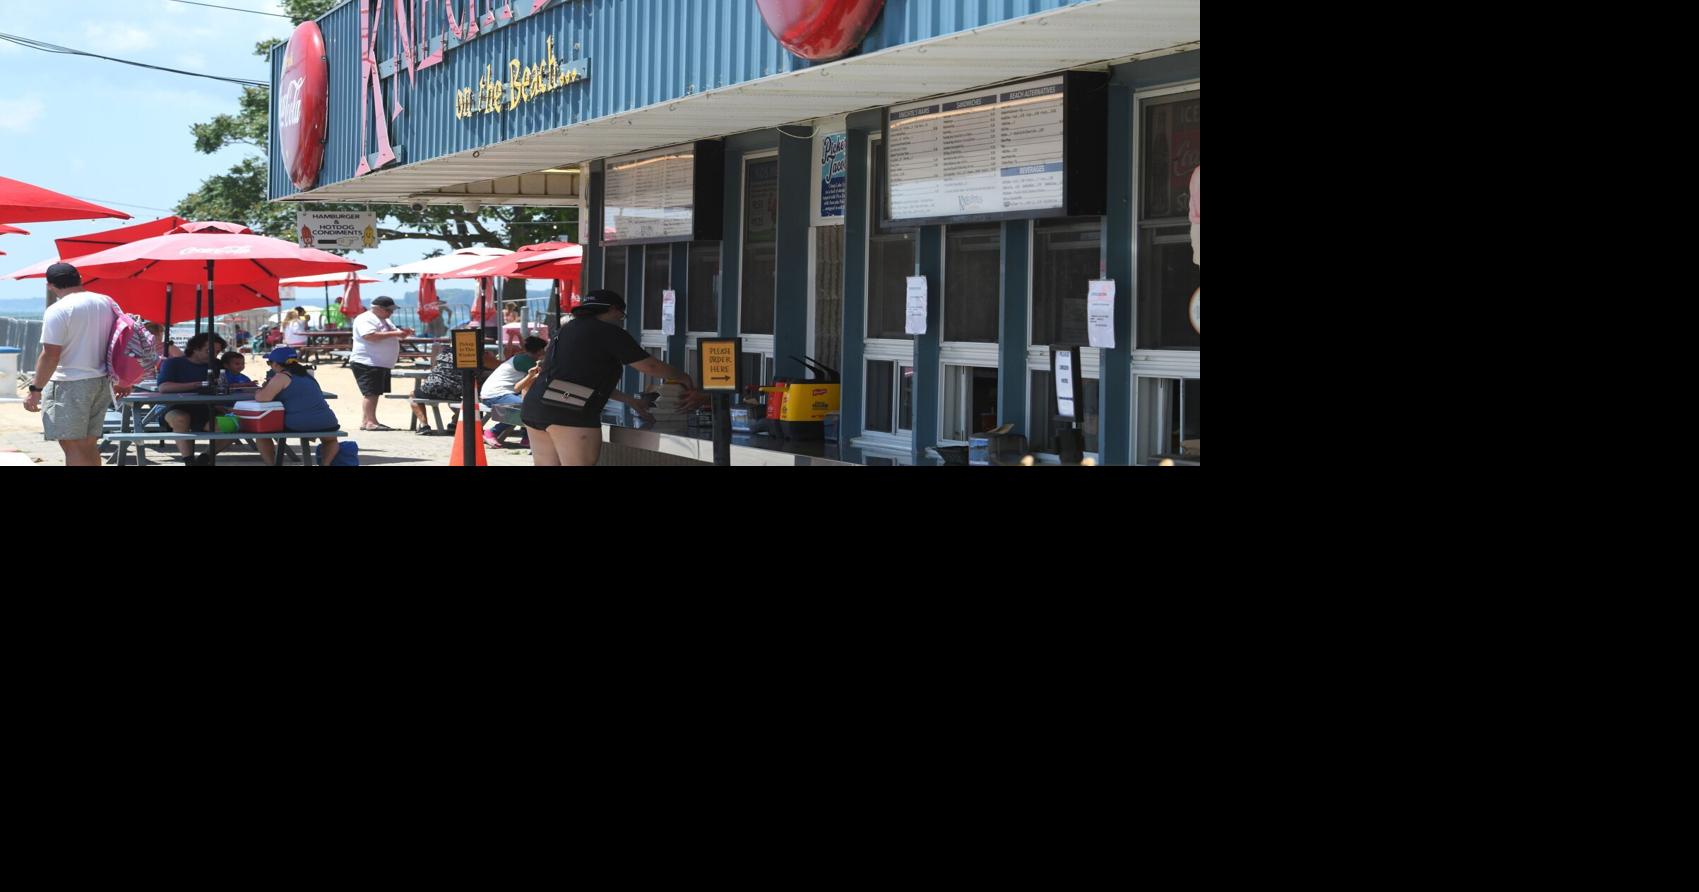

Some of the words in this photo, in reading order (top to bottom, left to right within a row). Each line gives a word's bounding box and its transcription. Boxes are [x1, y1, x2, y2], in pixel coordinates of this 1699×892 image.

[456, 87, 472, 120] on
[479, 64, 503, 114] the
[709, 347, 731, 355] PLEASE
[709, 355, 732, 363] ORDER
[710, 364, 728, 372] HERE
